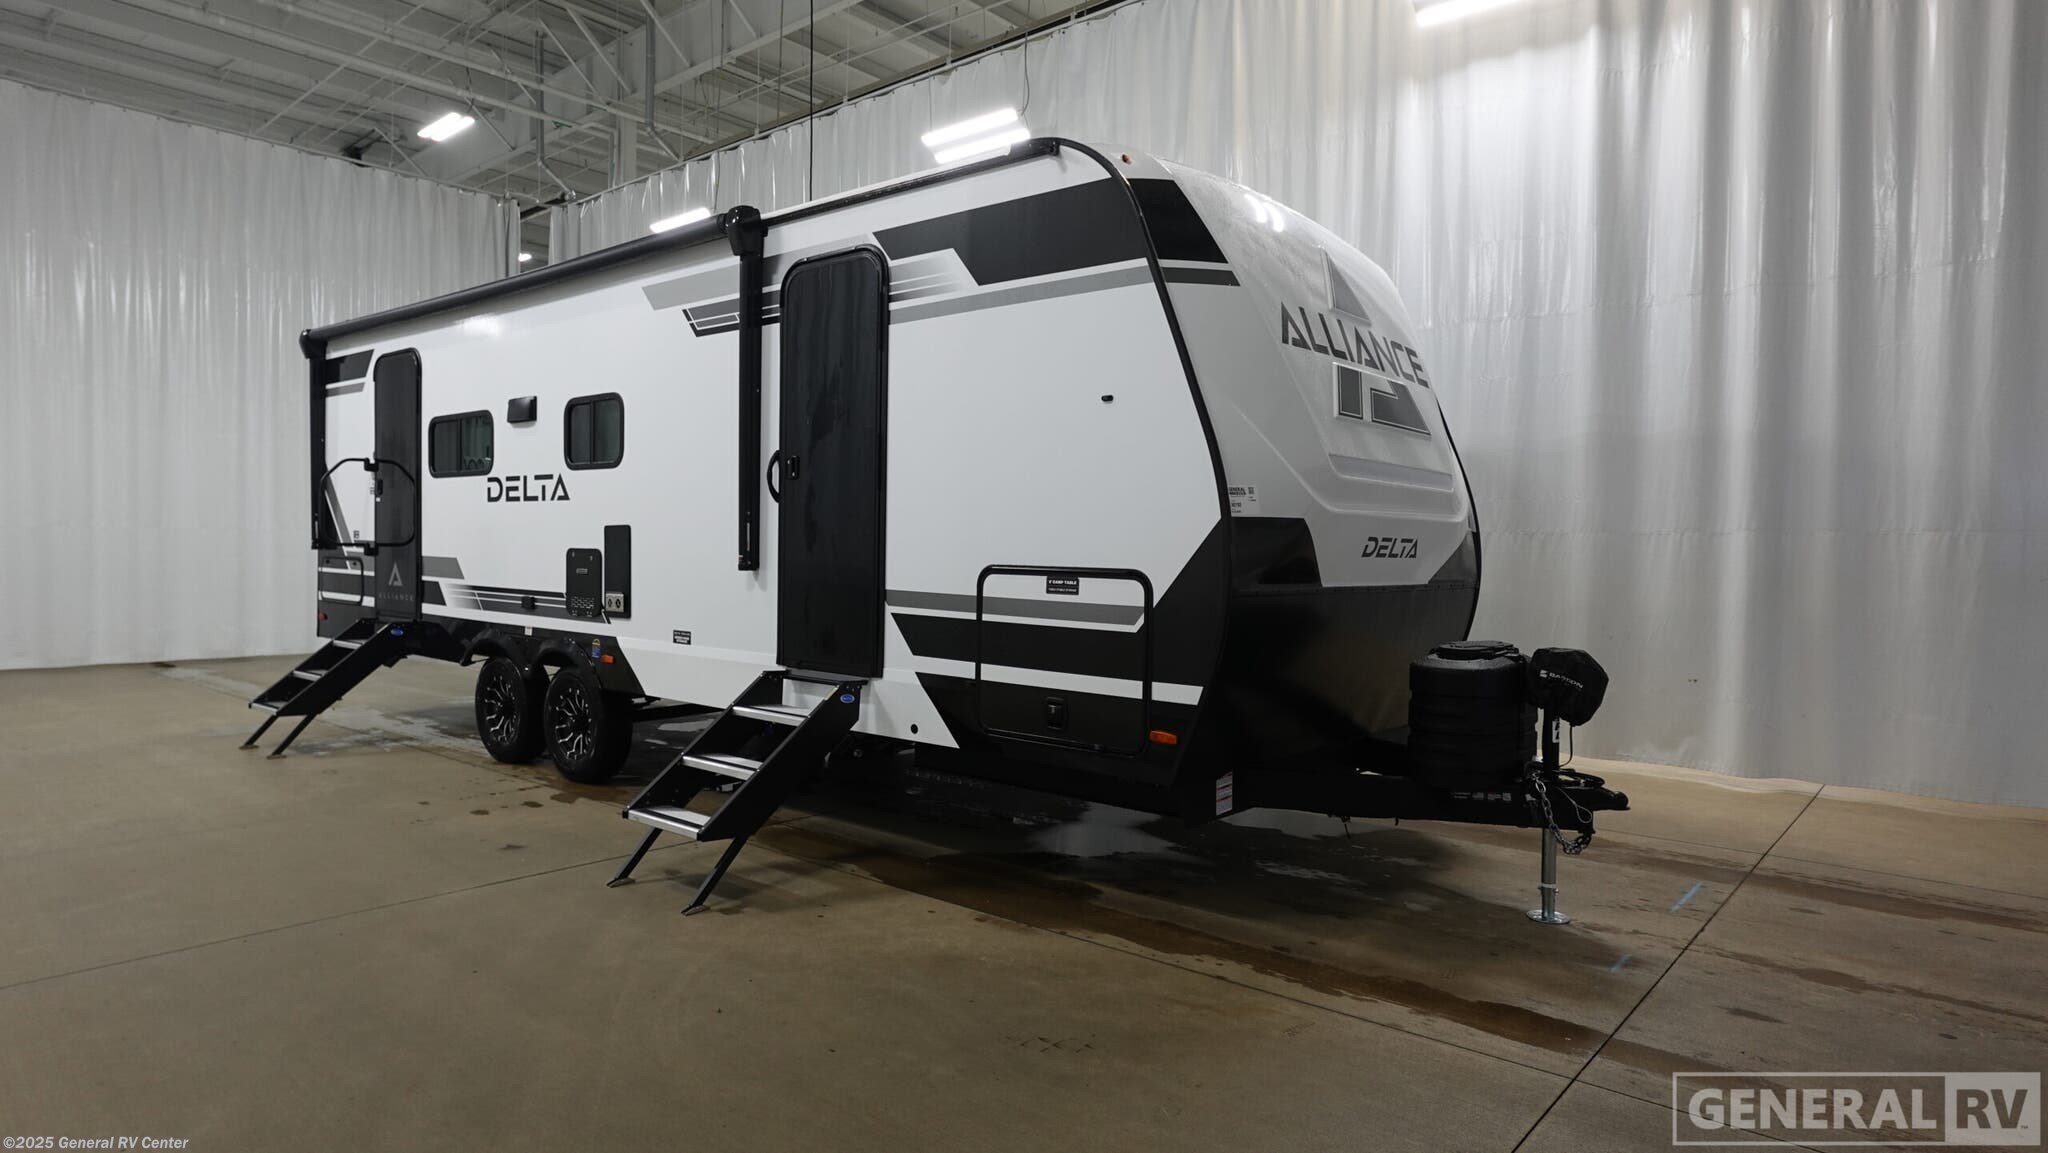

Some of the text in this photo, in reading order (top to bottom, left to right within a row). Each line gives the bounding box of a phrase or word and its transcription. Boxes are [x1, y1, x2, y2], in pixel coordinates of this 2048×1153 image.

[1281, 301, 1430, 389] ALLIANCE
[487, 474, 570, 502] DELTA
[1361, 536, 1418, 558] DELTA
